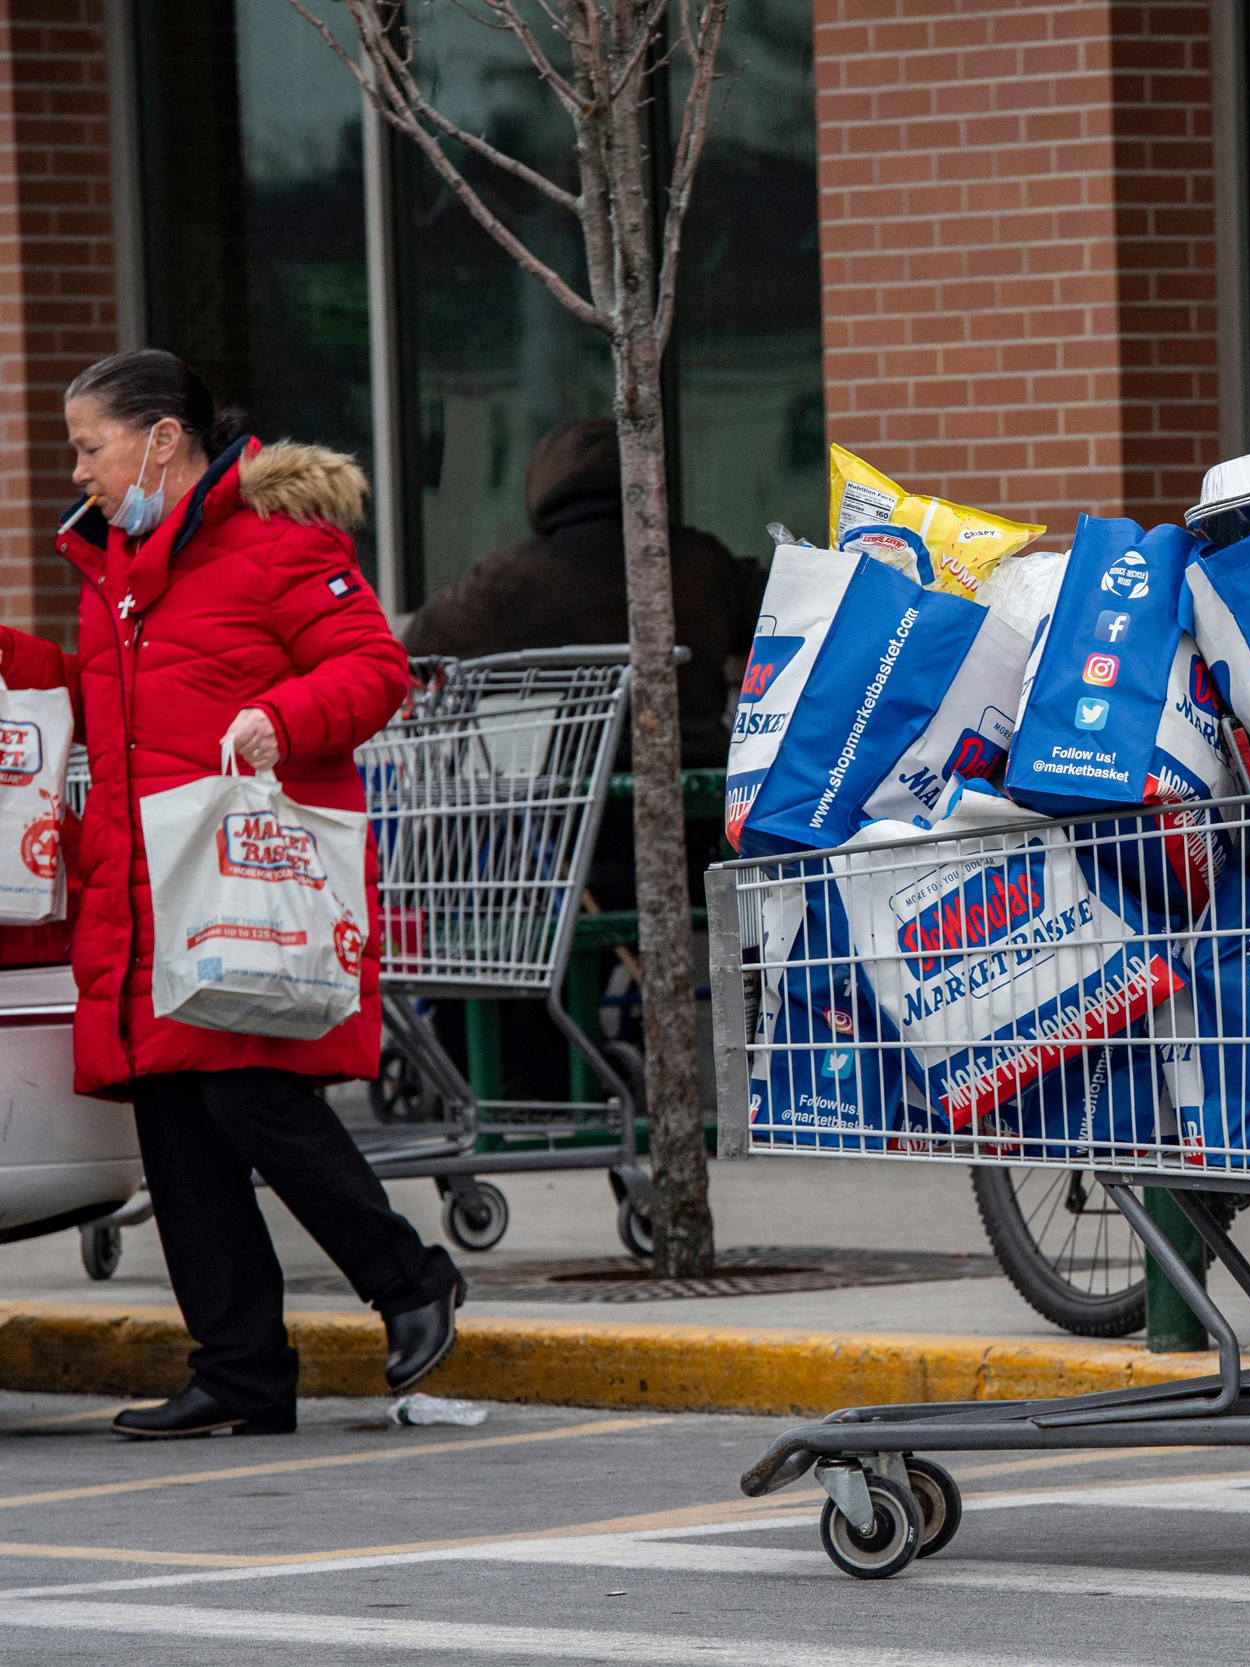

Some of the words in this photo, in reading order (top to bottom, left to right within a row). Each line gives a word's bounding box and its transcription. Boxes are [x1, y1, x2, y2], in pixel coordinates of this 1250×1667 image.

[847, 482, 877, 496] Nutrition
[842, 501, 865, 512] Calories
[875, 510, 889, 519] 160
[964, 529, 996, 540] CRISPY
[1117, 576, 1133, 587] REUSE
[808, 606, 919, 829] www.shopmarketbasket.com
[1051, 746, 1093, 760] Follow
[1095, 752, 1117, 764] us!
[1032, 759, 1130, 783] @marketbasket
[905, 890, 926, 908] MORE
[928, 881, 943, 895] FO
[943, 870, 965, 885] YOU
[224, 928, 237, 938] up
[238, 930, 249, 938] to
[251, 930, 270, 939] 125
[902, 950, 1008, 1027] MARKET
